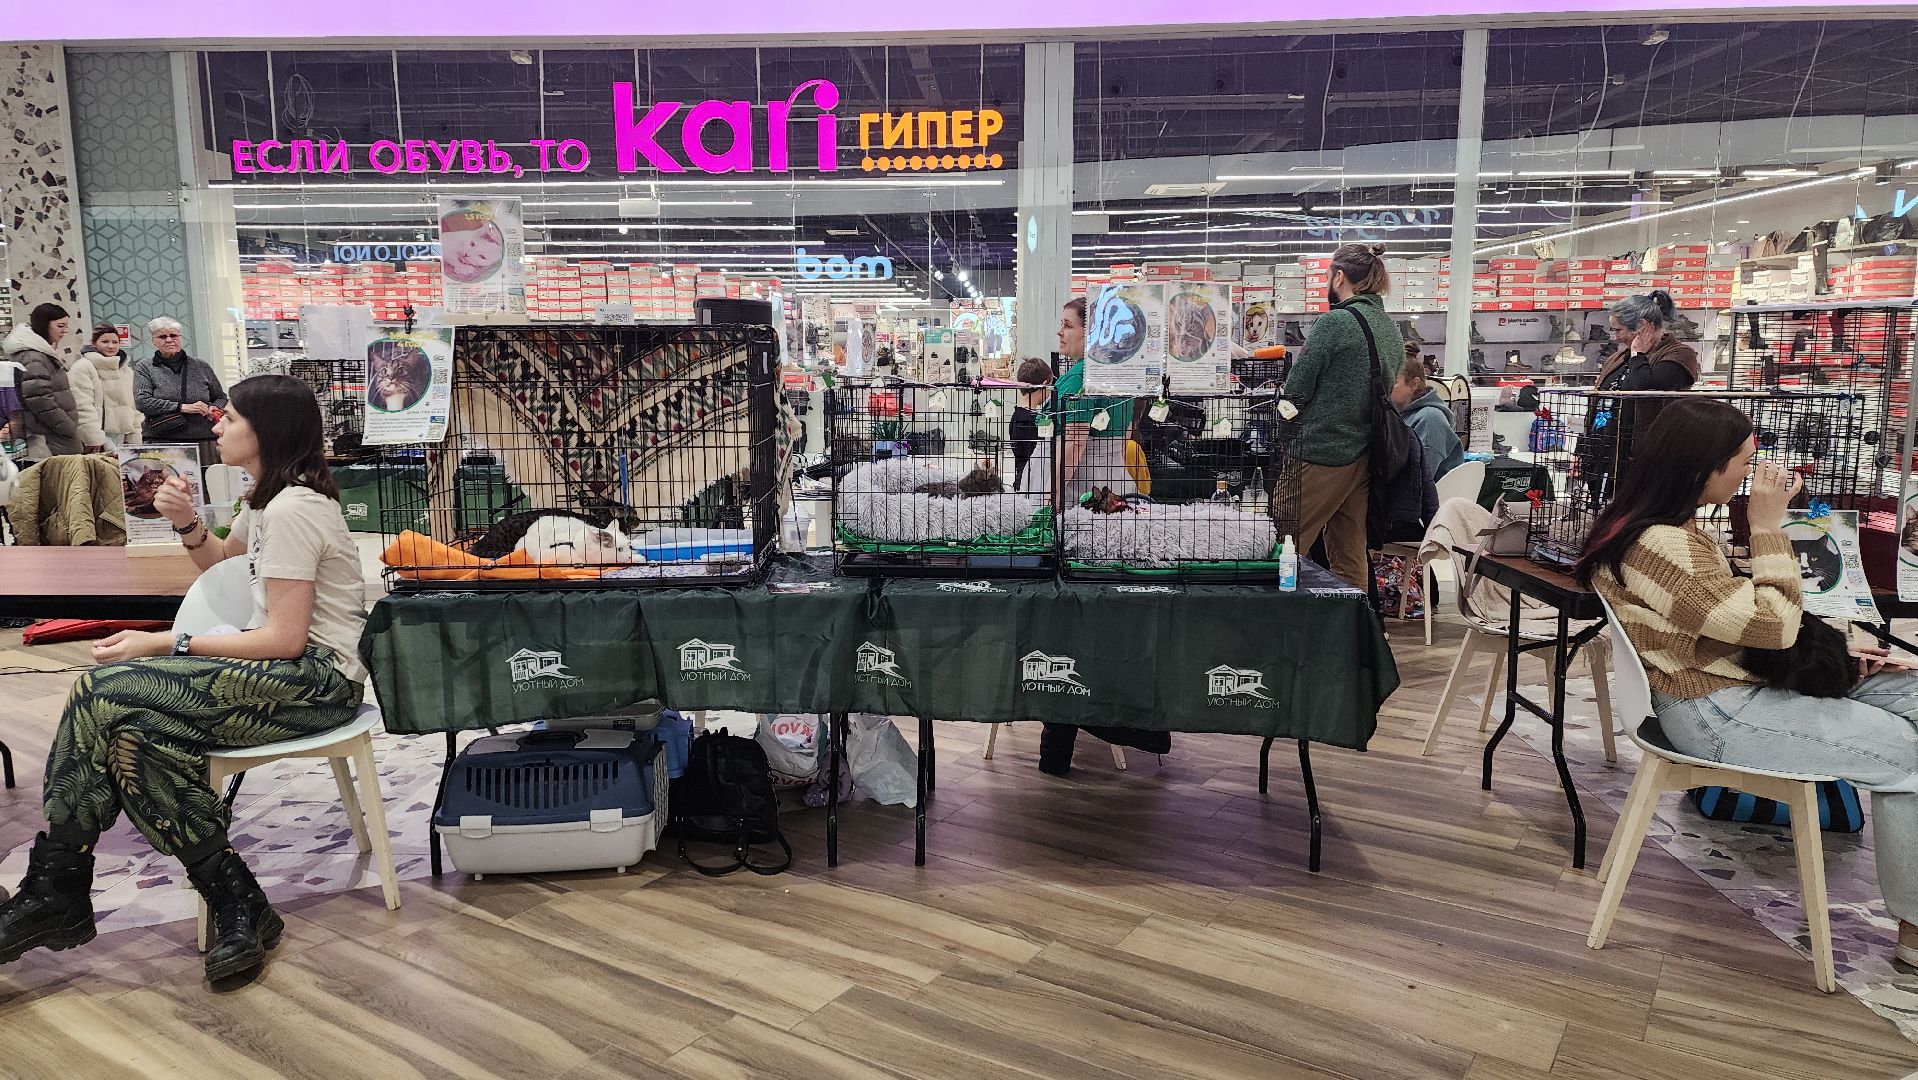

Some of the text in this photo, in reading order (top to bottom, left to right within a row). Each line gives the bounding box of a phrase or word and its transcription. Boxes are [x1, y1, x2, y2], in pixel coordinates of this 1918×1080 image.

[613, 79, 839, 173] kari
[859, 109, 1004, 150] ГИПЕР
[232, 139, 591, 178] ЕСЛИ ОБУВЬ, ТО
[680, 670, 752, 682] УЮТНЫЙ ДОМ
[890, 678, 912, 689] ДОМ
[512, 678, 585, 694] УЮТНЫЙ ДОМ
[1021, 681, 1091, 697] УЮТНЫЙ ДОМ
[1207, 696, 1280, 709] УЮТНЫЙ ДОМ
